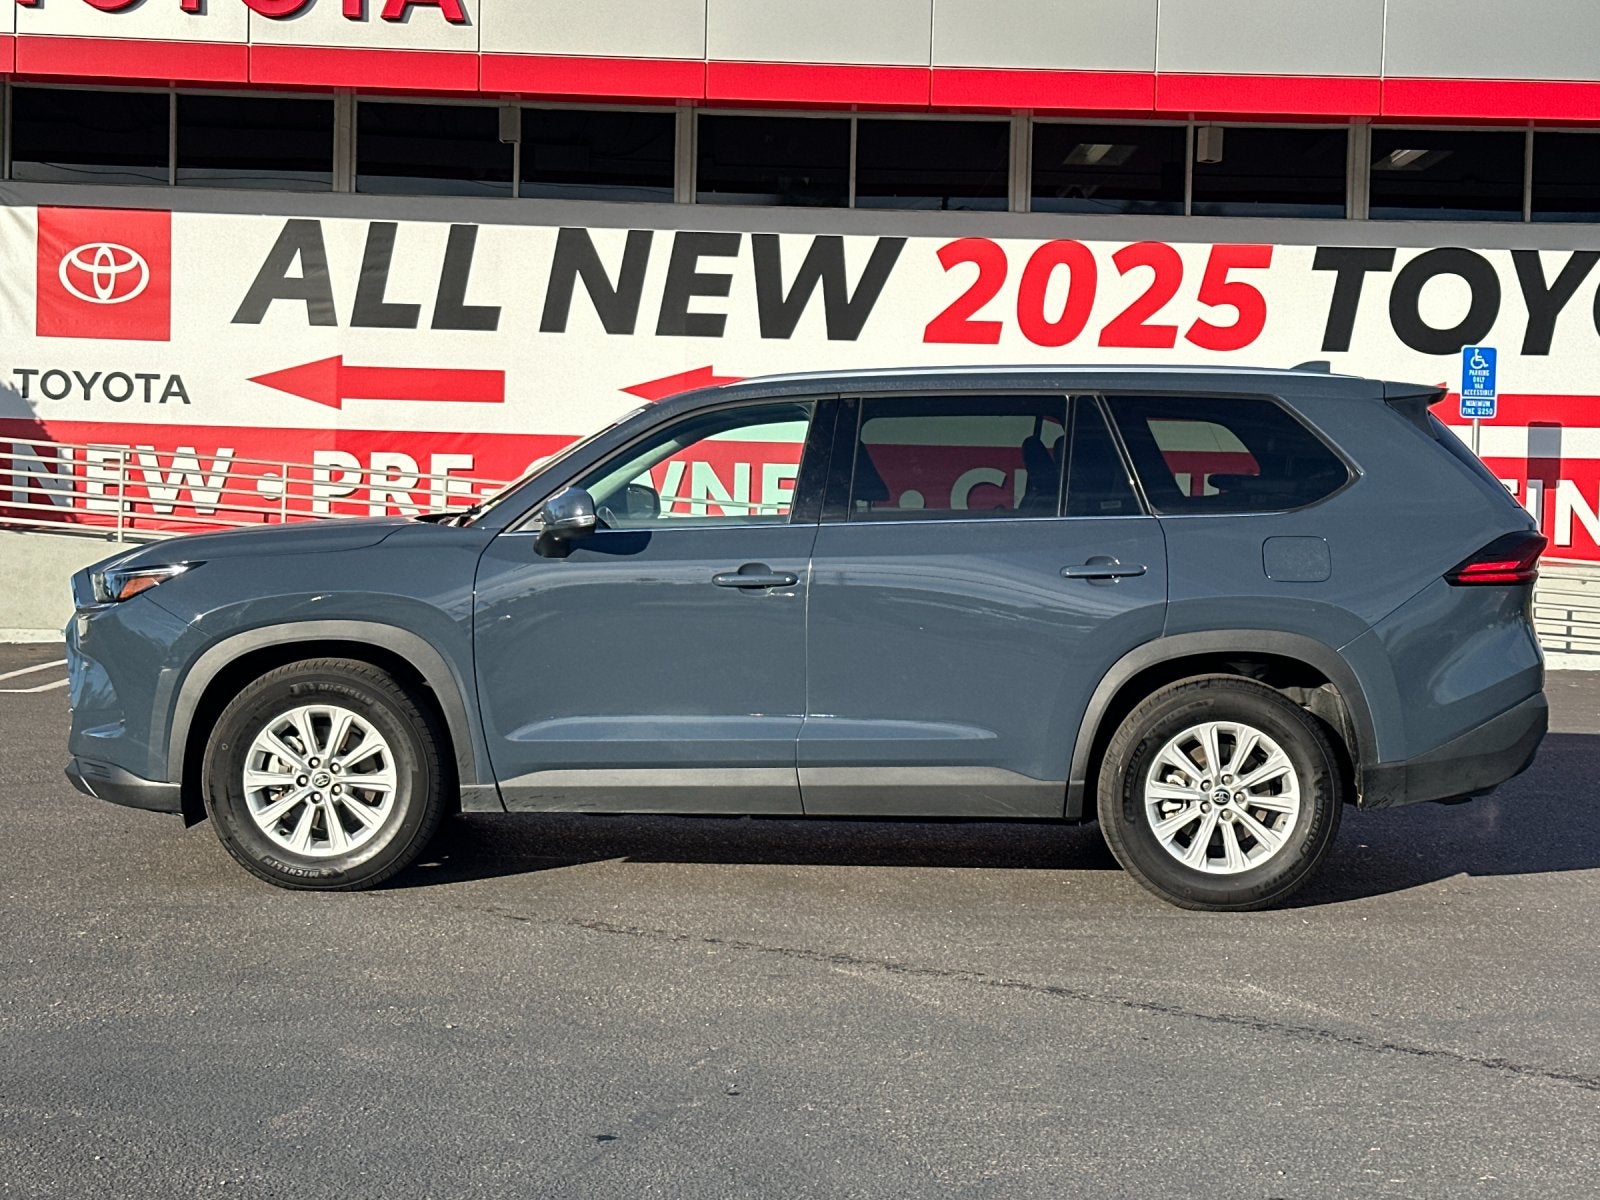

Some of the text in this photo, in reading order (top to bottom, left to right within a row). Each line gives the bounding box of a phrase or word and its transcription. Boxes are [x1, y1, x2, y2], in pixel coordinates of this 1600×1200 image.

[230, 219, 1600, 356] ALL NEW 2025 TOY
[13, 368, 191, 404] TOYOTA
[12, 443, 234, 514] NEW
[318, 683, 374, 705] MICHELIN
[262, 857, 319, 879] MICHELIN
